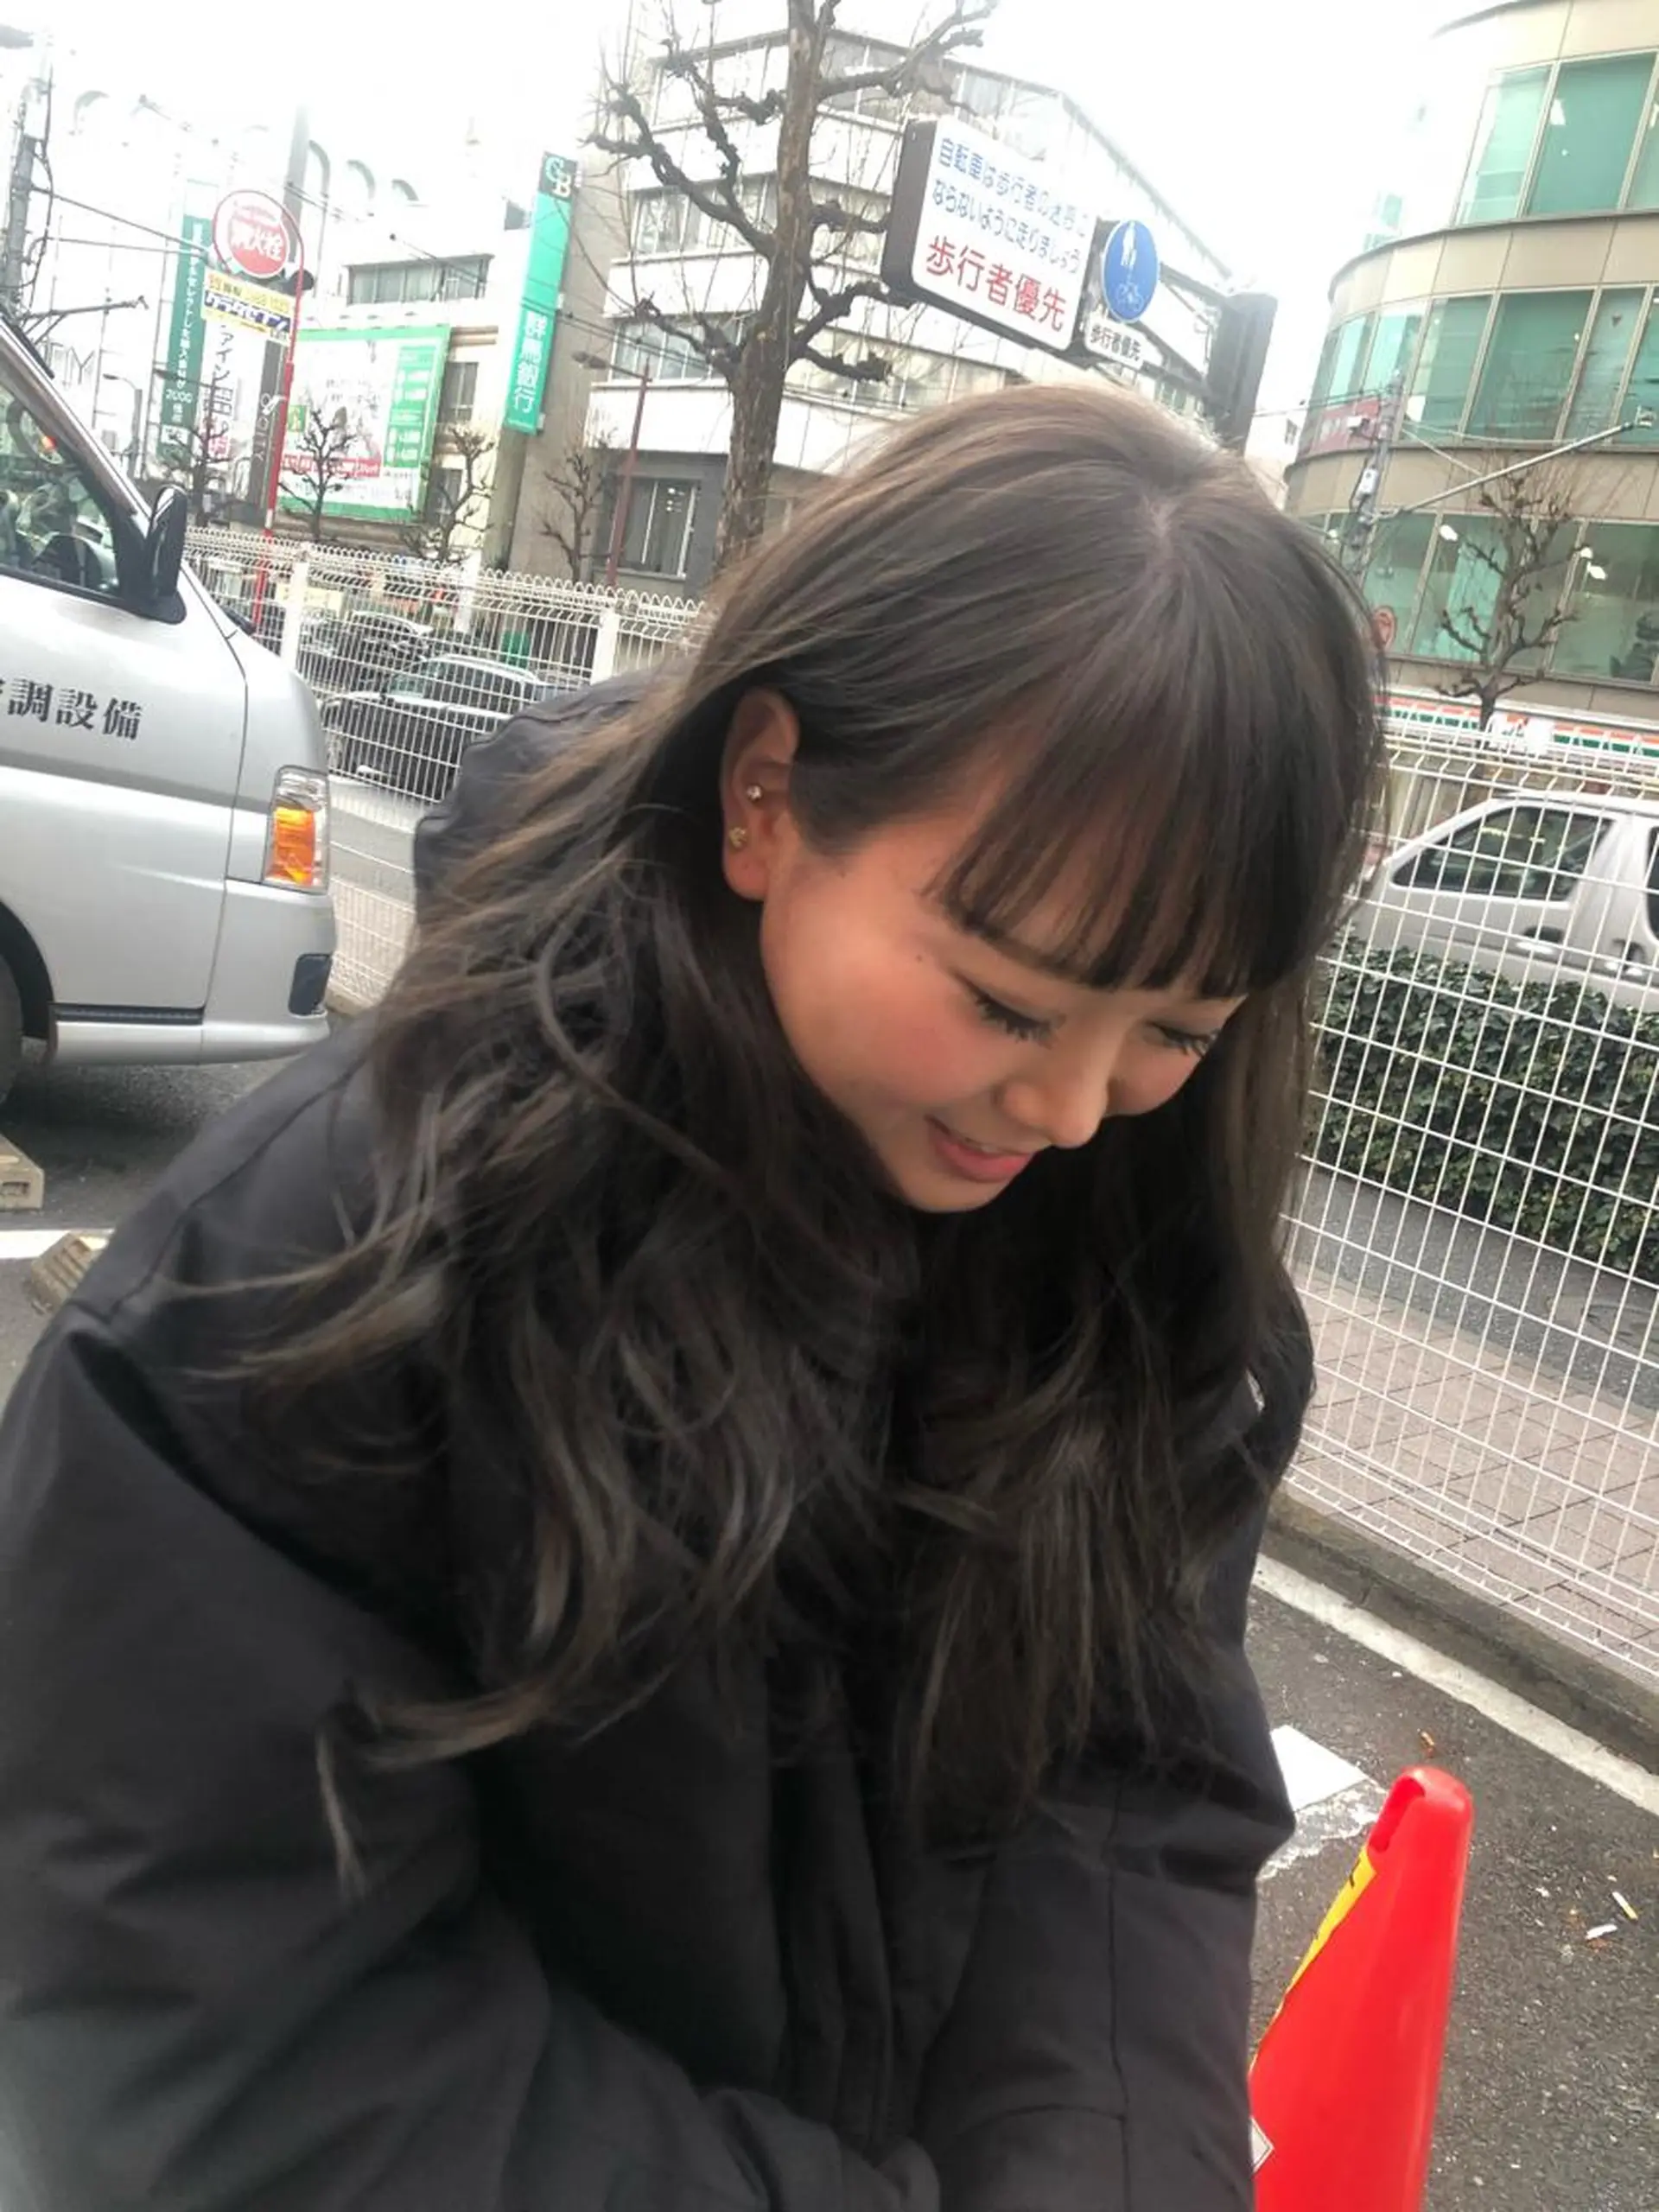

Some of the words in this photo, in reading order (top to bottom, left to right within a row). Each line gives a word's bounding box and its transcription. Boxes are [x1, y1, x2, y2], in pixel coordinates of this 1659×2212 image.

[925, 235, 1067, 333] 歩行者優先
[512, 310, 547, 413] 群馬銀行
[0, 677, 143, 741] 調設備
